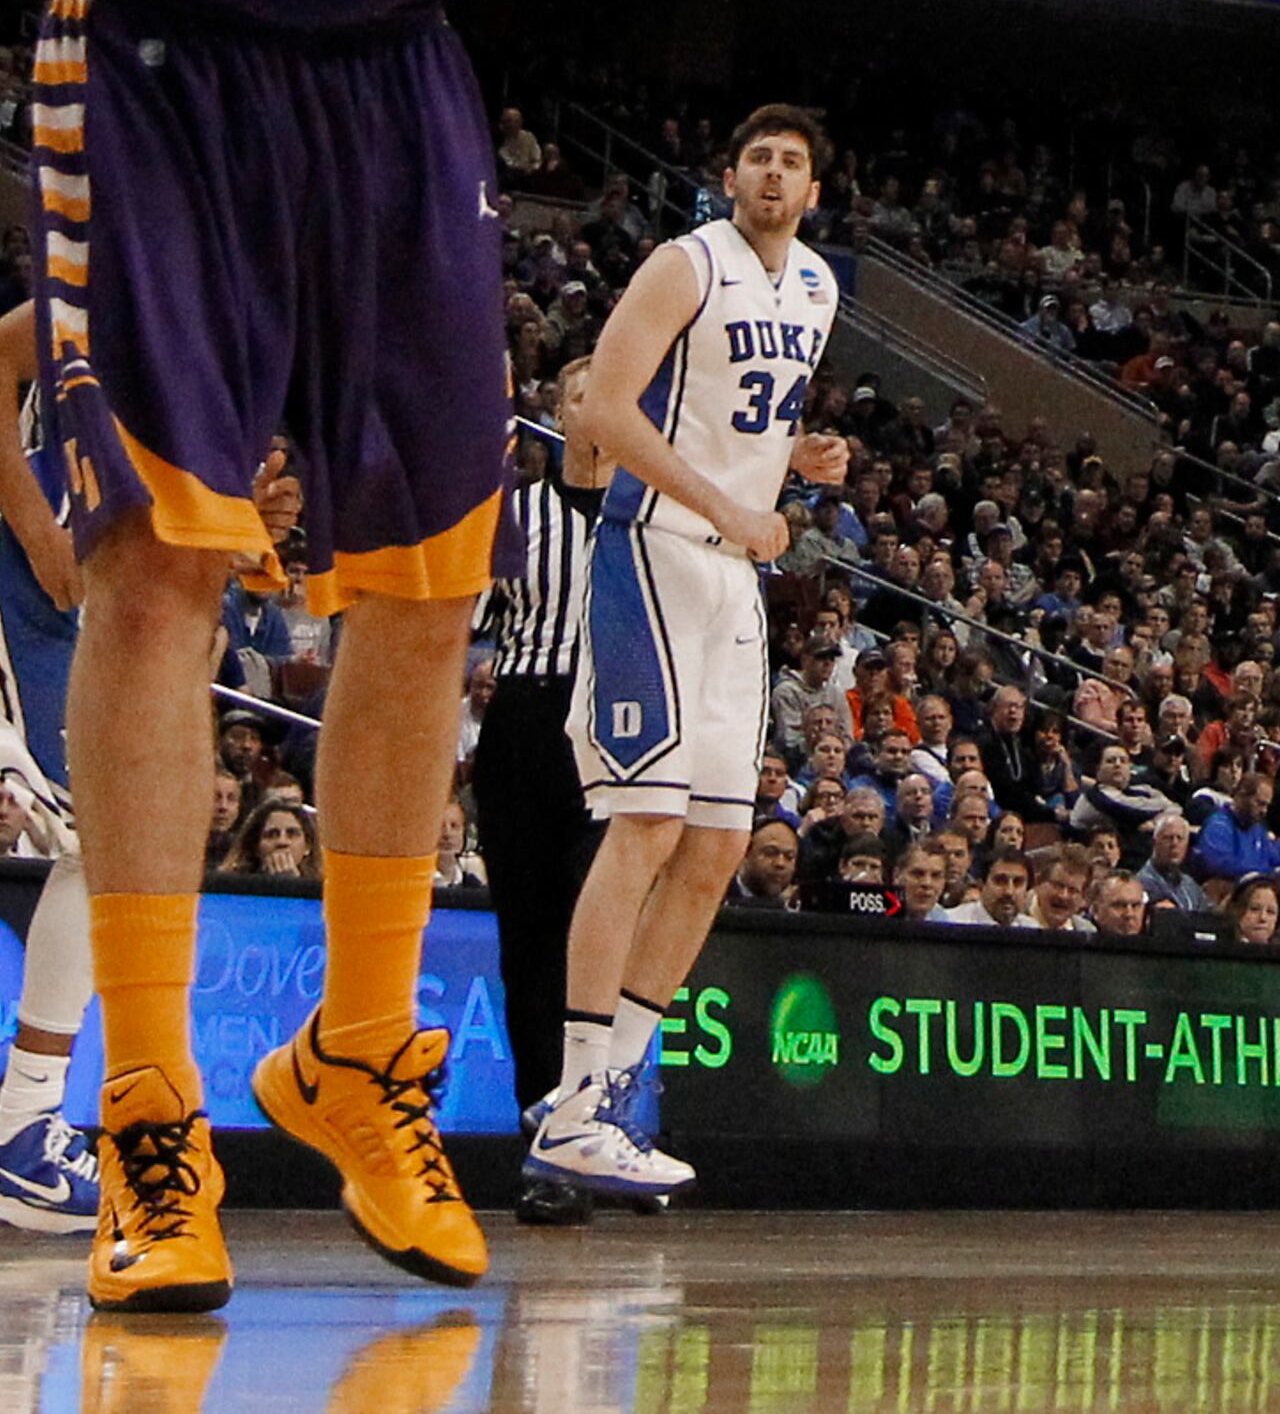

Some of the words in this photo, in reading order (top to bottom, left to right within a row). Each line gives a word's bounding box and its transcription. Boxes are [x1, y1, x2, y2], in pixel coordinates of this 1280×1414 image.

[725, 320, 822, 366] DUKE
[731, 372, 807, 437] 34
[611, 700, 642, 739] D
[849, 891, 886, 912] POSS.
[195, 921, 326, 998] Dove
[771, 1031, 839, 1066] NCAA
